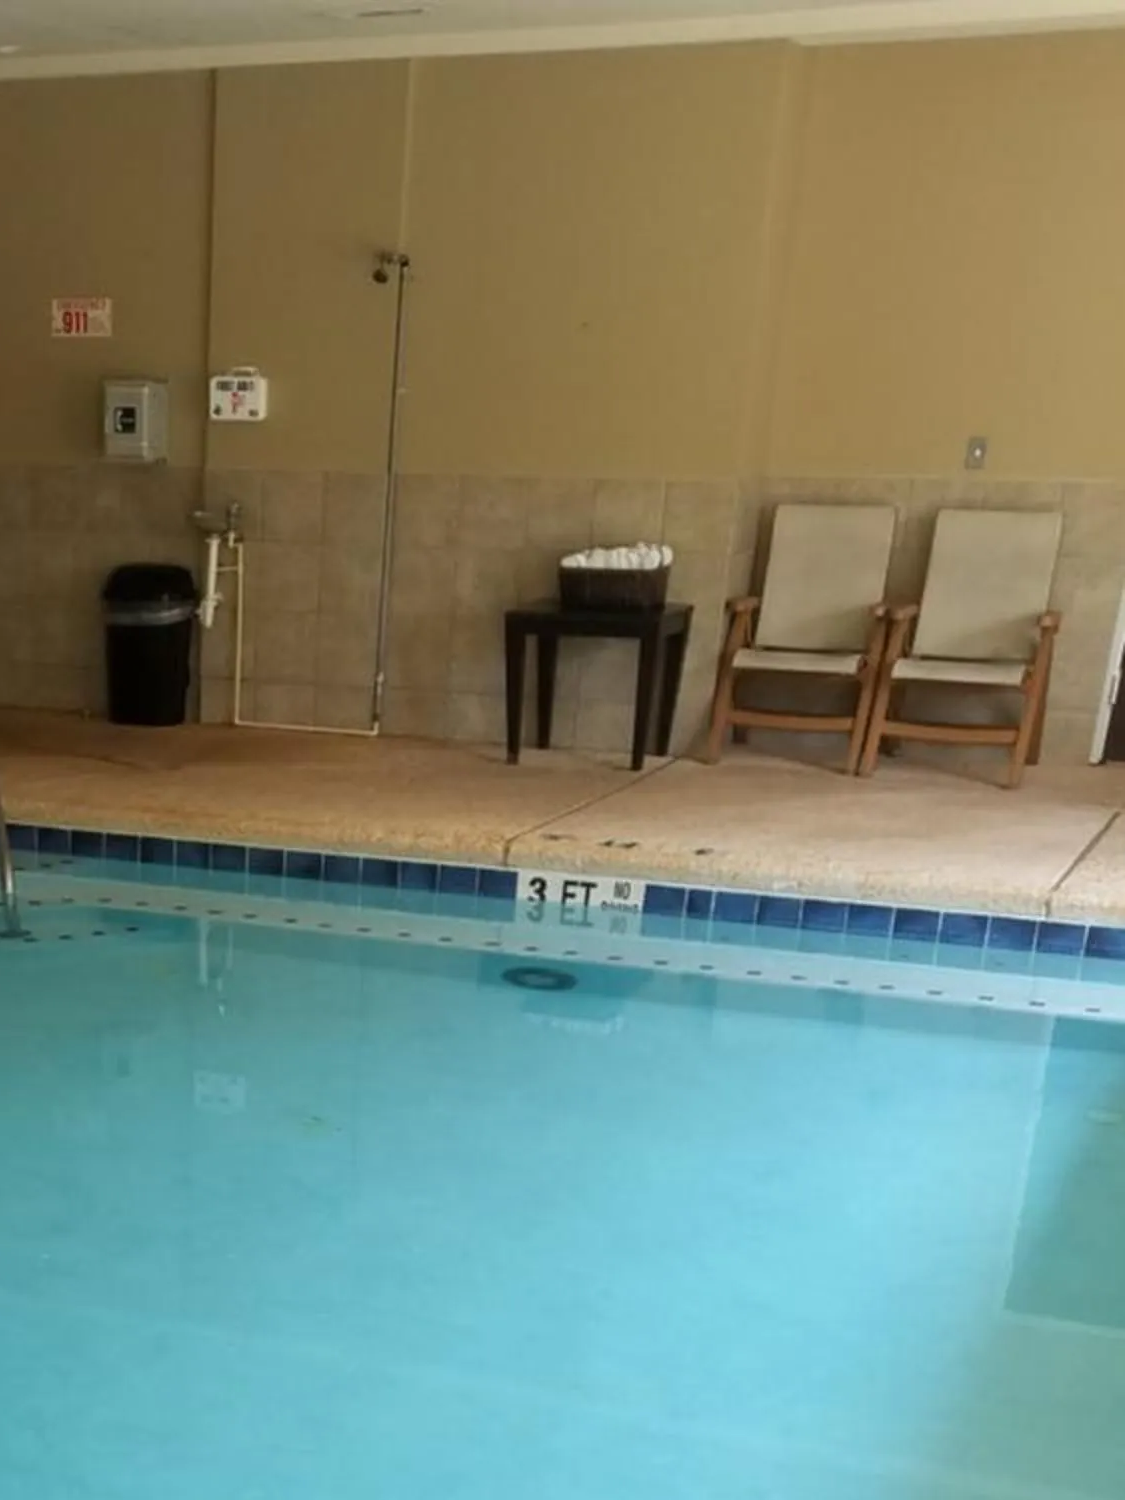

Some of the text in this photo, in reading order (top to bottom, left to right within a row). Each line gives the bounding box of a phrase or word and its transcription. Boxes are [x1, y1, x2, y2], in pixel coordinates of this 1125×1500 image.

[62, 311, 87, 334] 911
[529, 877, 547, 903] 3
[562, 880, 597, 907] FT
[614, 882, 631, 899] NO
